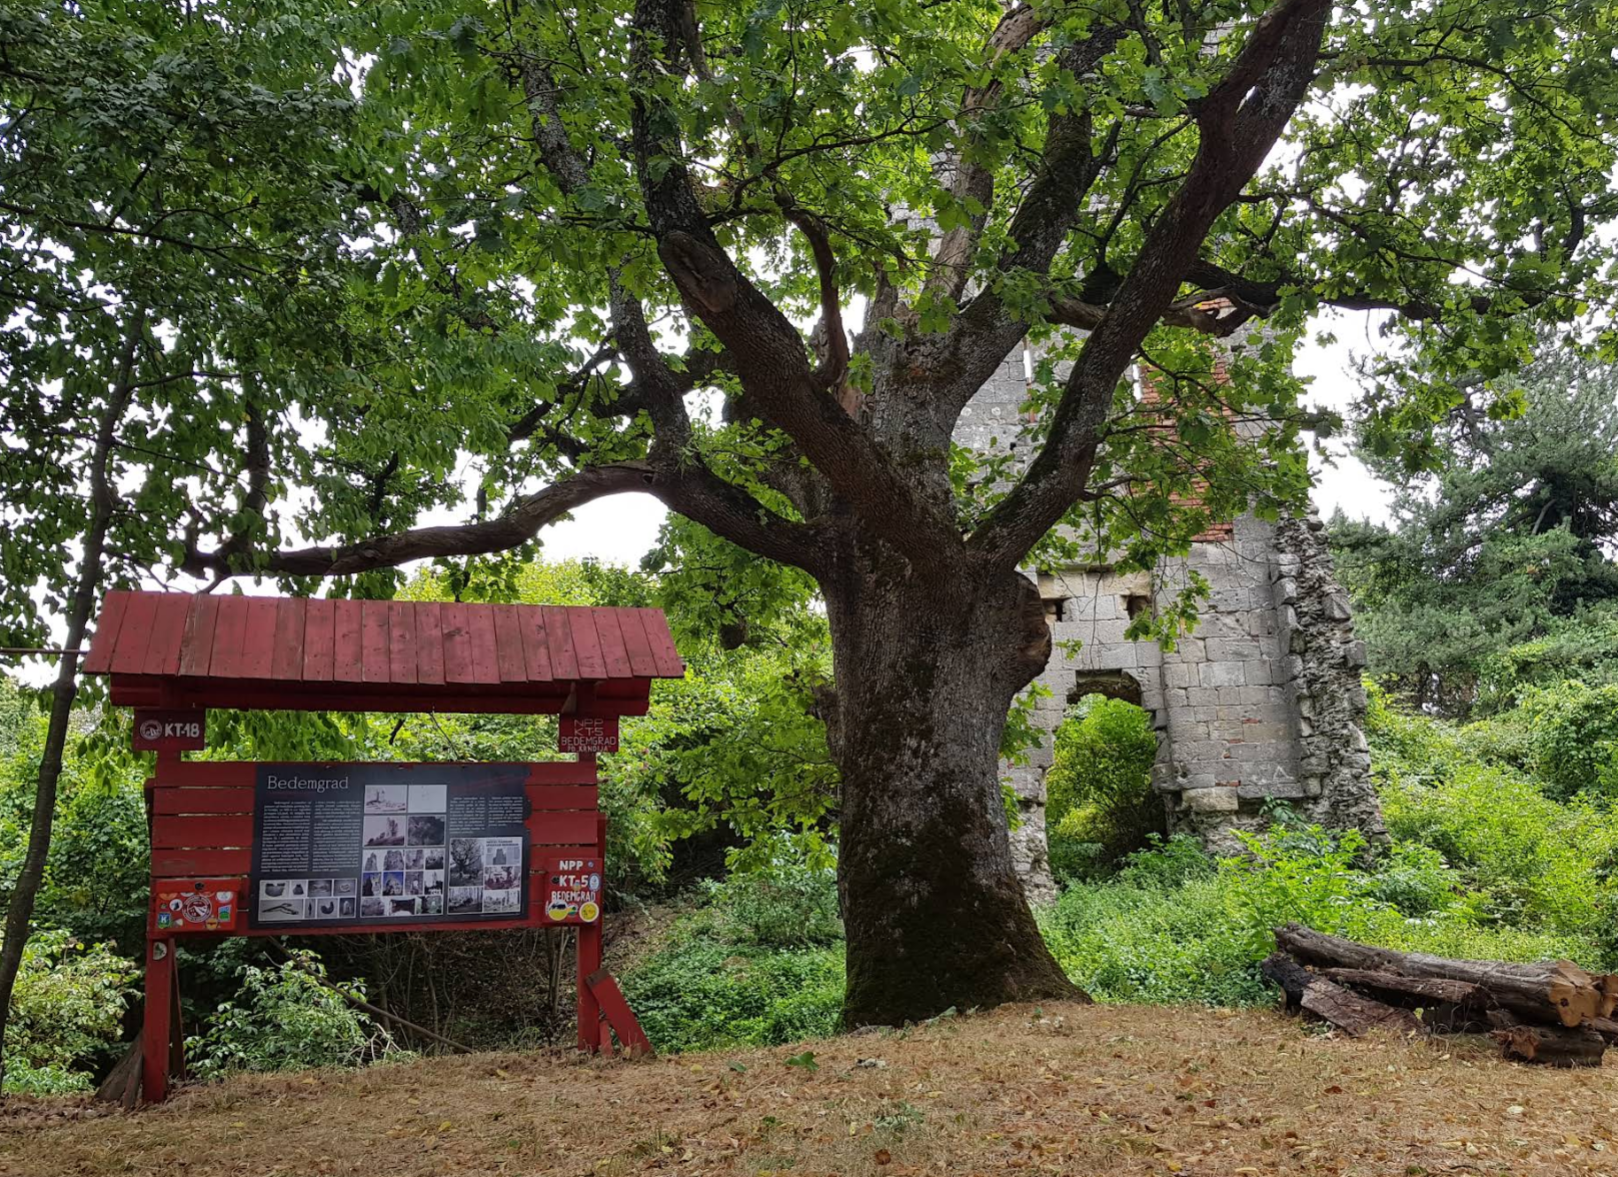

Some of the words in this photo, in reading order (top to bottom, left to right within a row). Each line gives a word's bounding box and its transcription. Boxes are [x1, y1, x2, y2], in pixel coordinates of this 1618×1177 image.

[574, 718, 604, 728] NPP
[164, 723, 200, 738] KT-18
[561, 736, 617, 746] BEDEMGRAD
[267, 775, 349, 793] Bedemgrad
[559, 860, 584, 871] NPP
[551, 890, 596, 902] BEDEMGRAD
